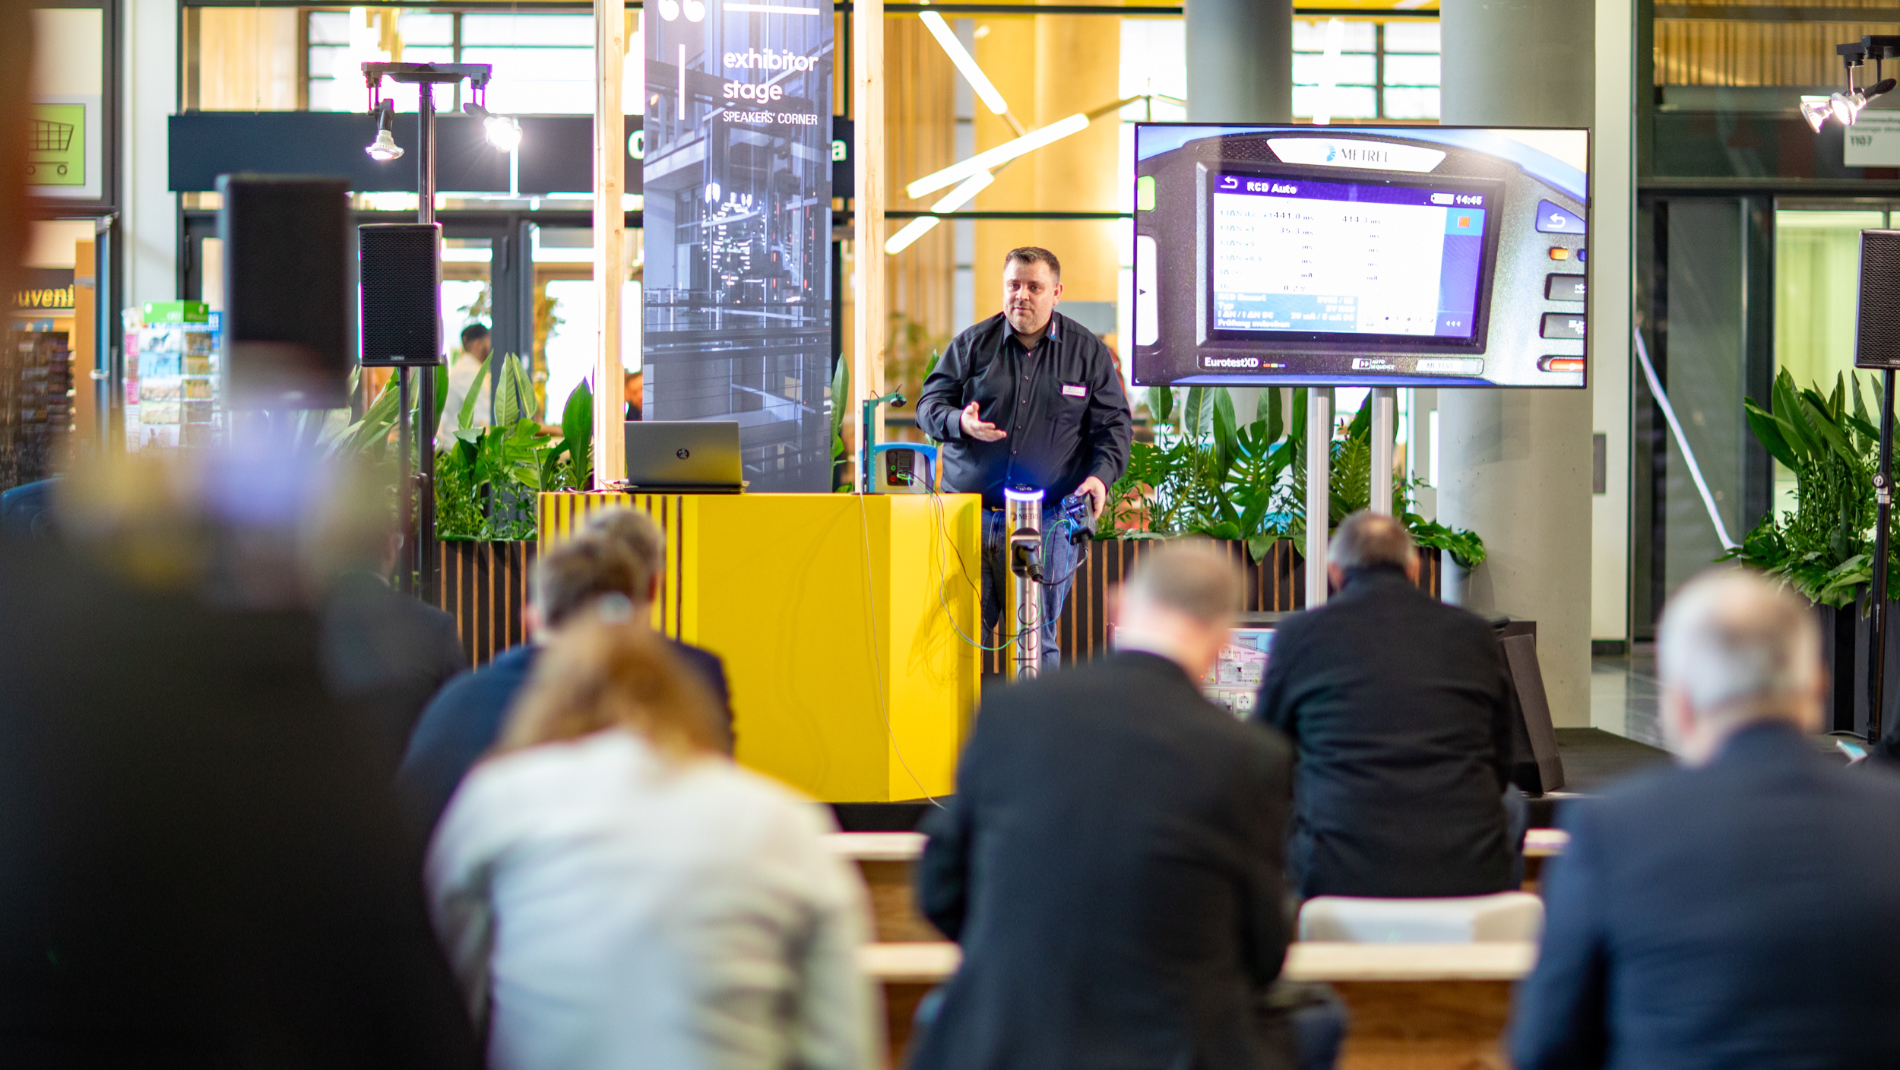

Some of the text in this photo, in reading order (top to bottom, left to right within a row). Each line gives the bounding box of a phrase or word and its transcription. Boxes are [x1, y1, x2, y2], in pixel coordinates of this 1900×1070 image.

[723, 48, 819, 72] exhibitor
[723, 80, 782, 104] stage
[723, 110, 818, 125] SPEAKERS' CORNER
[1341, 148, 1388, 162] METREL
[1246, 182, 1297, 195] RCD Auto
[13, 284, 74, 307] uveni
[1204, 356, 1260, 368] EurotestXD
